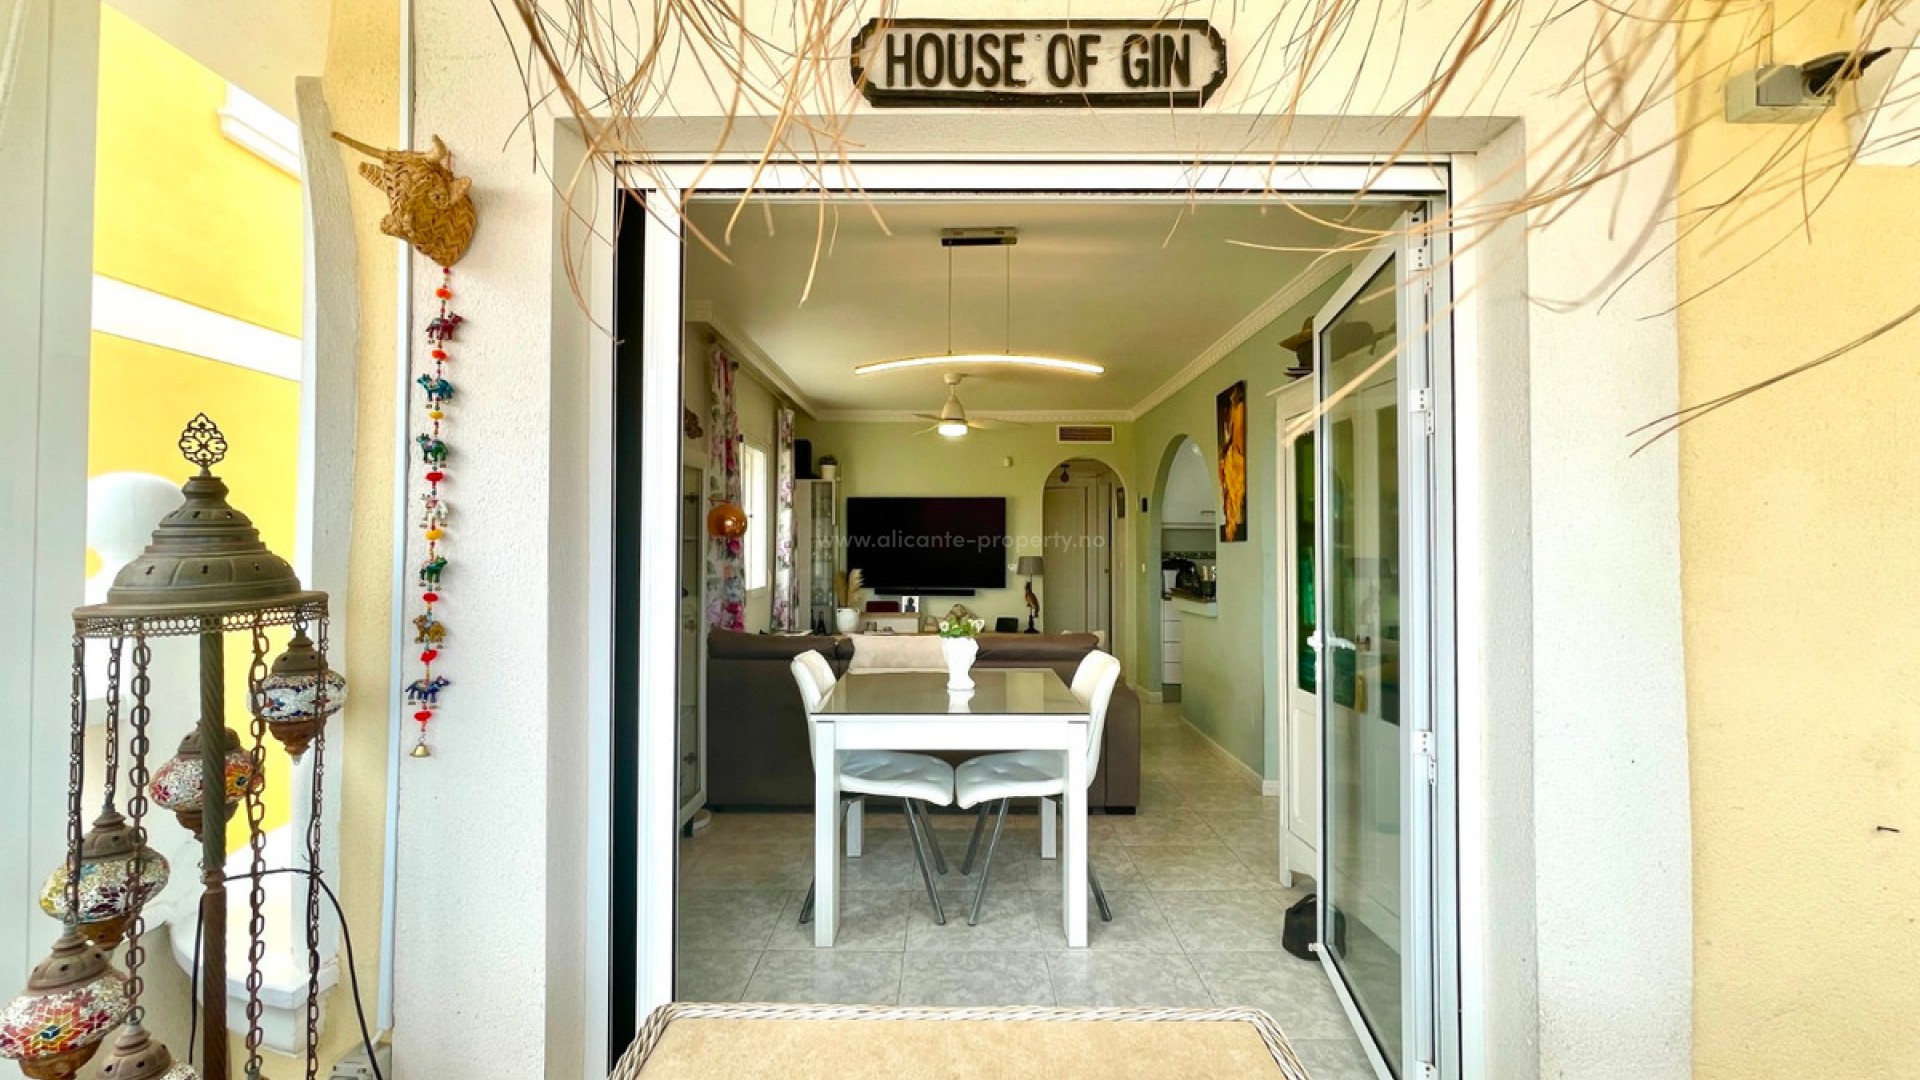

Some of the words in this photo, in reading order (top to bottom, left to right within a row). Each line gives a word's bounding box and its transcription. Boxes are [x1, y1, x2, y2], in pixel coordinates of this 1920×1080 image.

[886, 33, 1027, 87] HOUSE
[1048, 33, 1101, 88] OF
[1122, 33, 1190, 88] GIN
